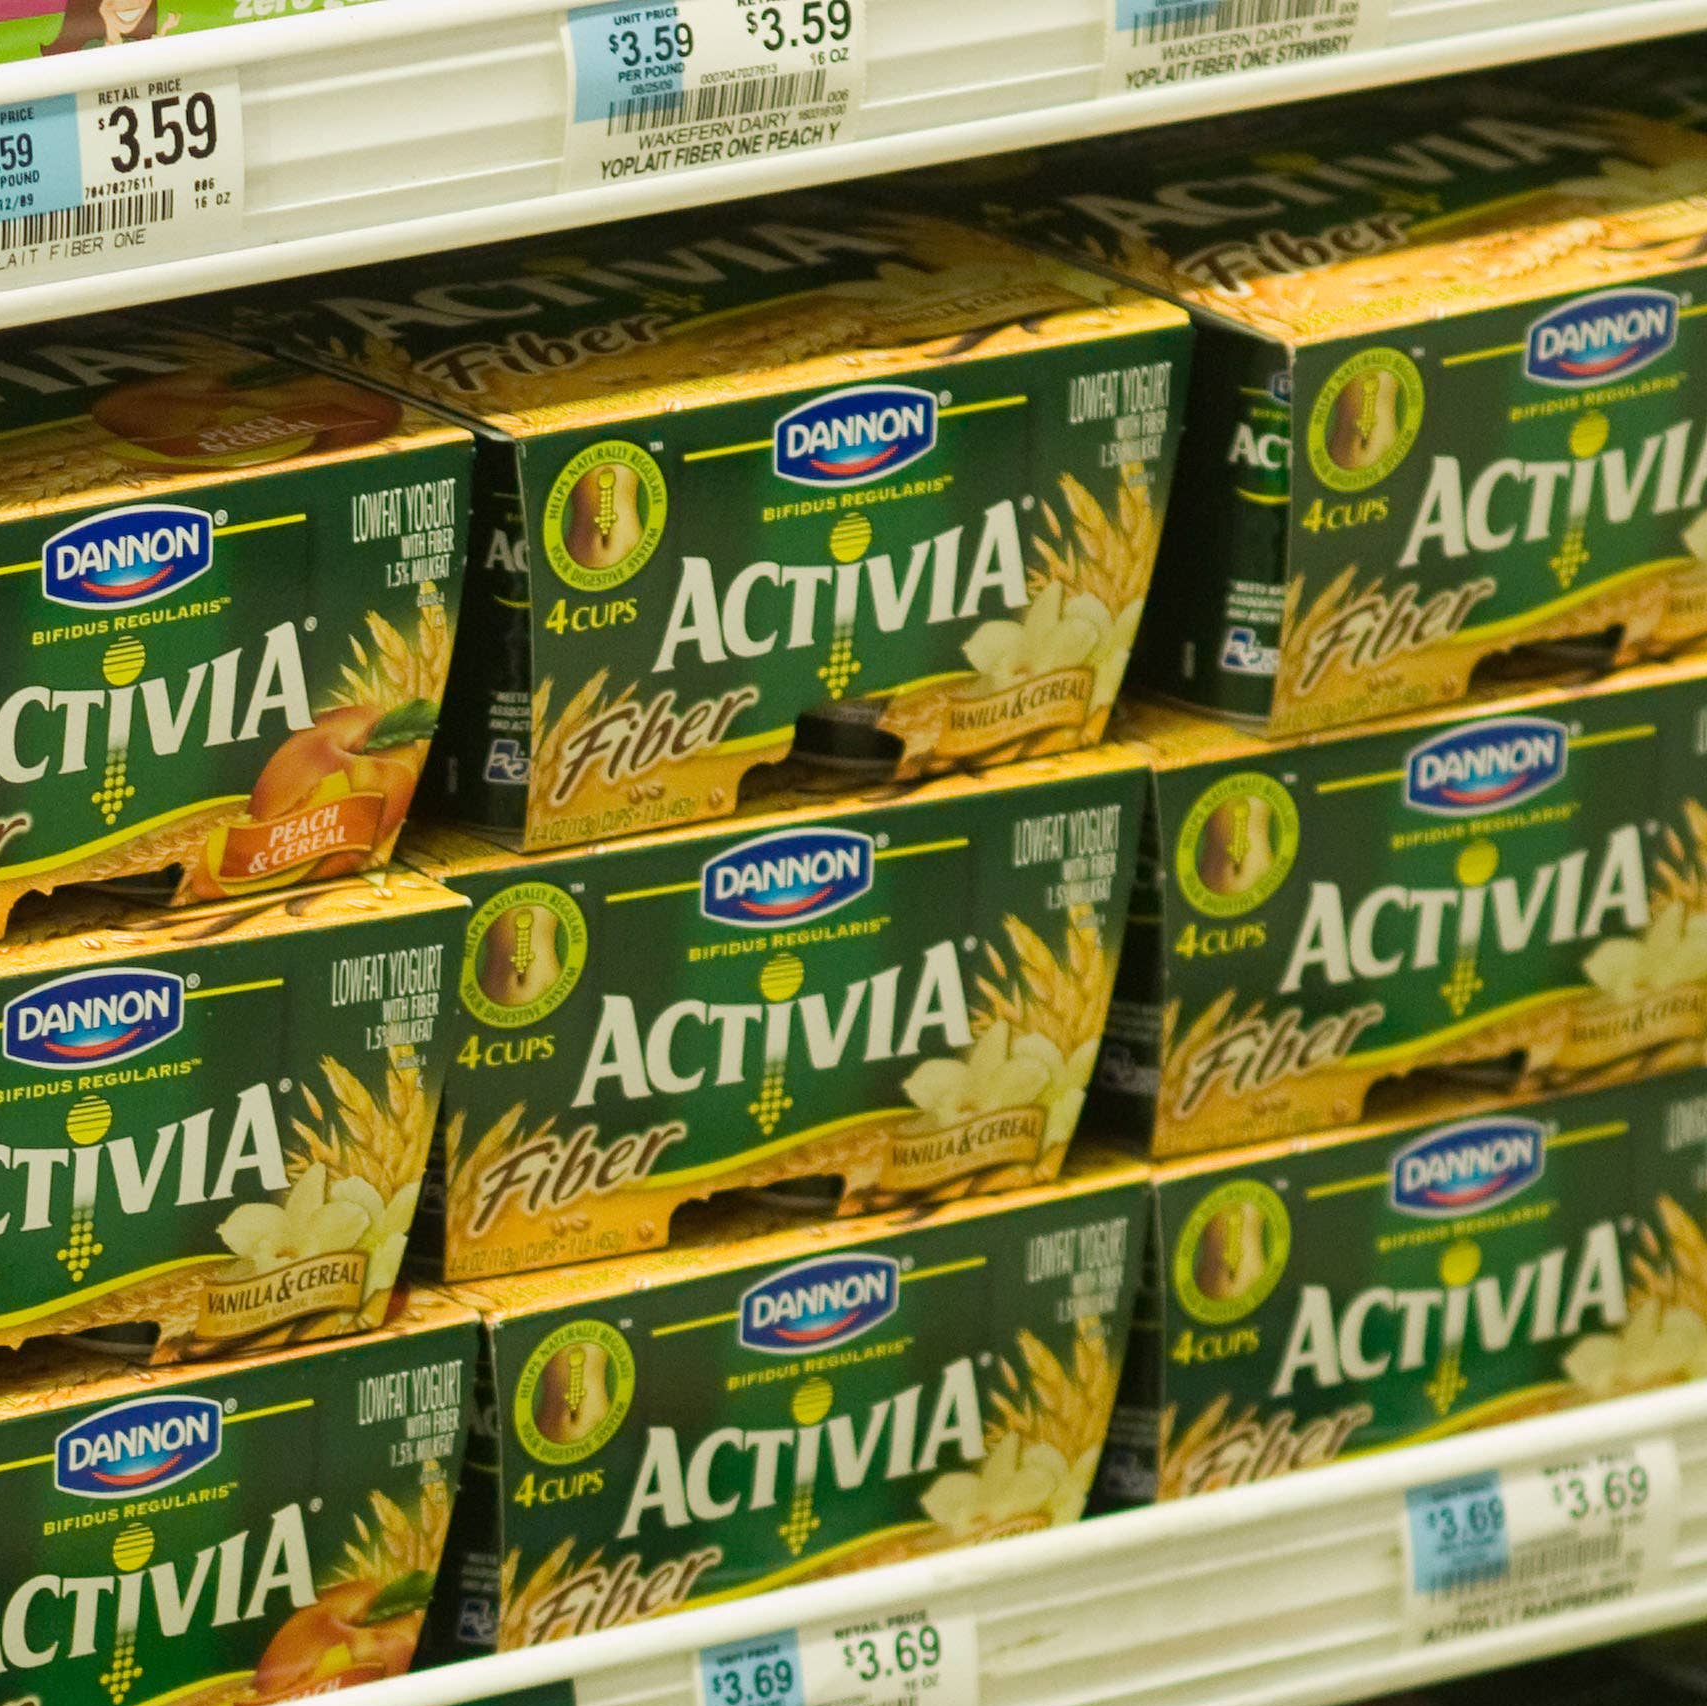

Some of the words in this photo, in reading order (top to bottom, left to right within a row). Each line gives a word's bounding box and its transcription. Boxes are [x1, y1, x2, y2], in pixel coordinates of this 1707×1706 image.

[609, 22, 694, 67] $3.59
[746, 0, 851, 51] $3.59
[1192, 54, 1236, 78] FIBER
[1241, 49, 1272, 70] ONE
[98, 90, 139, 106] RETAIL
[148, 79, 182, 95] PRICE
[601, 149, 669, 180] YOPLAIT
[675, 142, 724, 168] FIBER
[727, 134, 762, 158] ONE
[767, 124, 823, 152] PEACH
[828, 121, 841, 142] Y
[639, 124, 733, 150] WAKEFERN
[739, 111, 791, 134] DAIRY
[49, 236, 103, 260] FIBER
[114, 228, 147, 248] ONE
[786, 403, 926, 459] DANNON
[352, 492, 400, 543] LOWFAT
[401, 478, 456, 528] YOGURT
[1398, 420, 1707, 569] ACTIVI
[57, 525, 201, 581] DANNON
[652, 500, 1031, 674] ACTIVIA
[32, 619, 109, 647] BIFIDUS
[114, 599, 223, 632] REGULARIS
[555, 686, 759, 805] Fiber
[1418, 736, 1556, 791] DANNON
[247, 848, 272, 876] &
[273, 824, 348, 866] CEREAL
[269, 804, 339, 849] PEACH
[715, 847, 862, 899] DANNON
[1279, 824, 1652, 995] ACTIVIA
[16, 987, 171, 1039] DANNON
[571, 941, 974, 1109] ACTIVIA
[208, 1284, 276, 1318] VANILLA
[276, 1274, 296, 1301] &
[298, 1259, 361, 1293] CEREAL
[843, 1625, 941, 1682] $3.69
